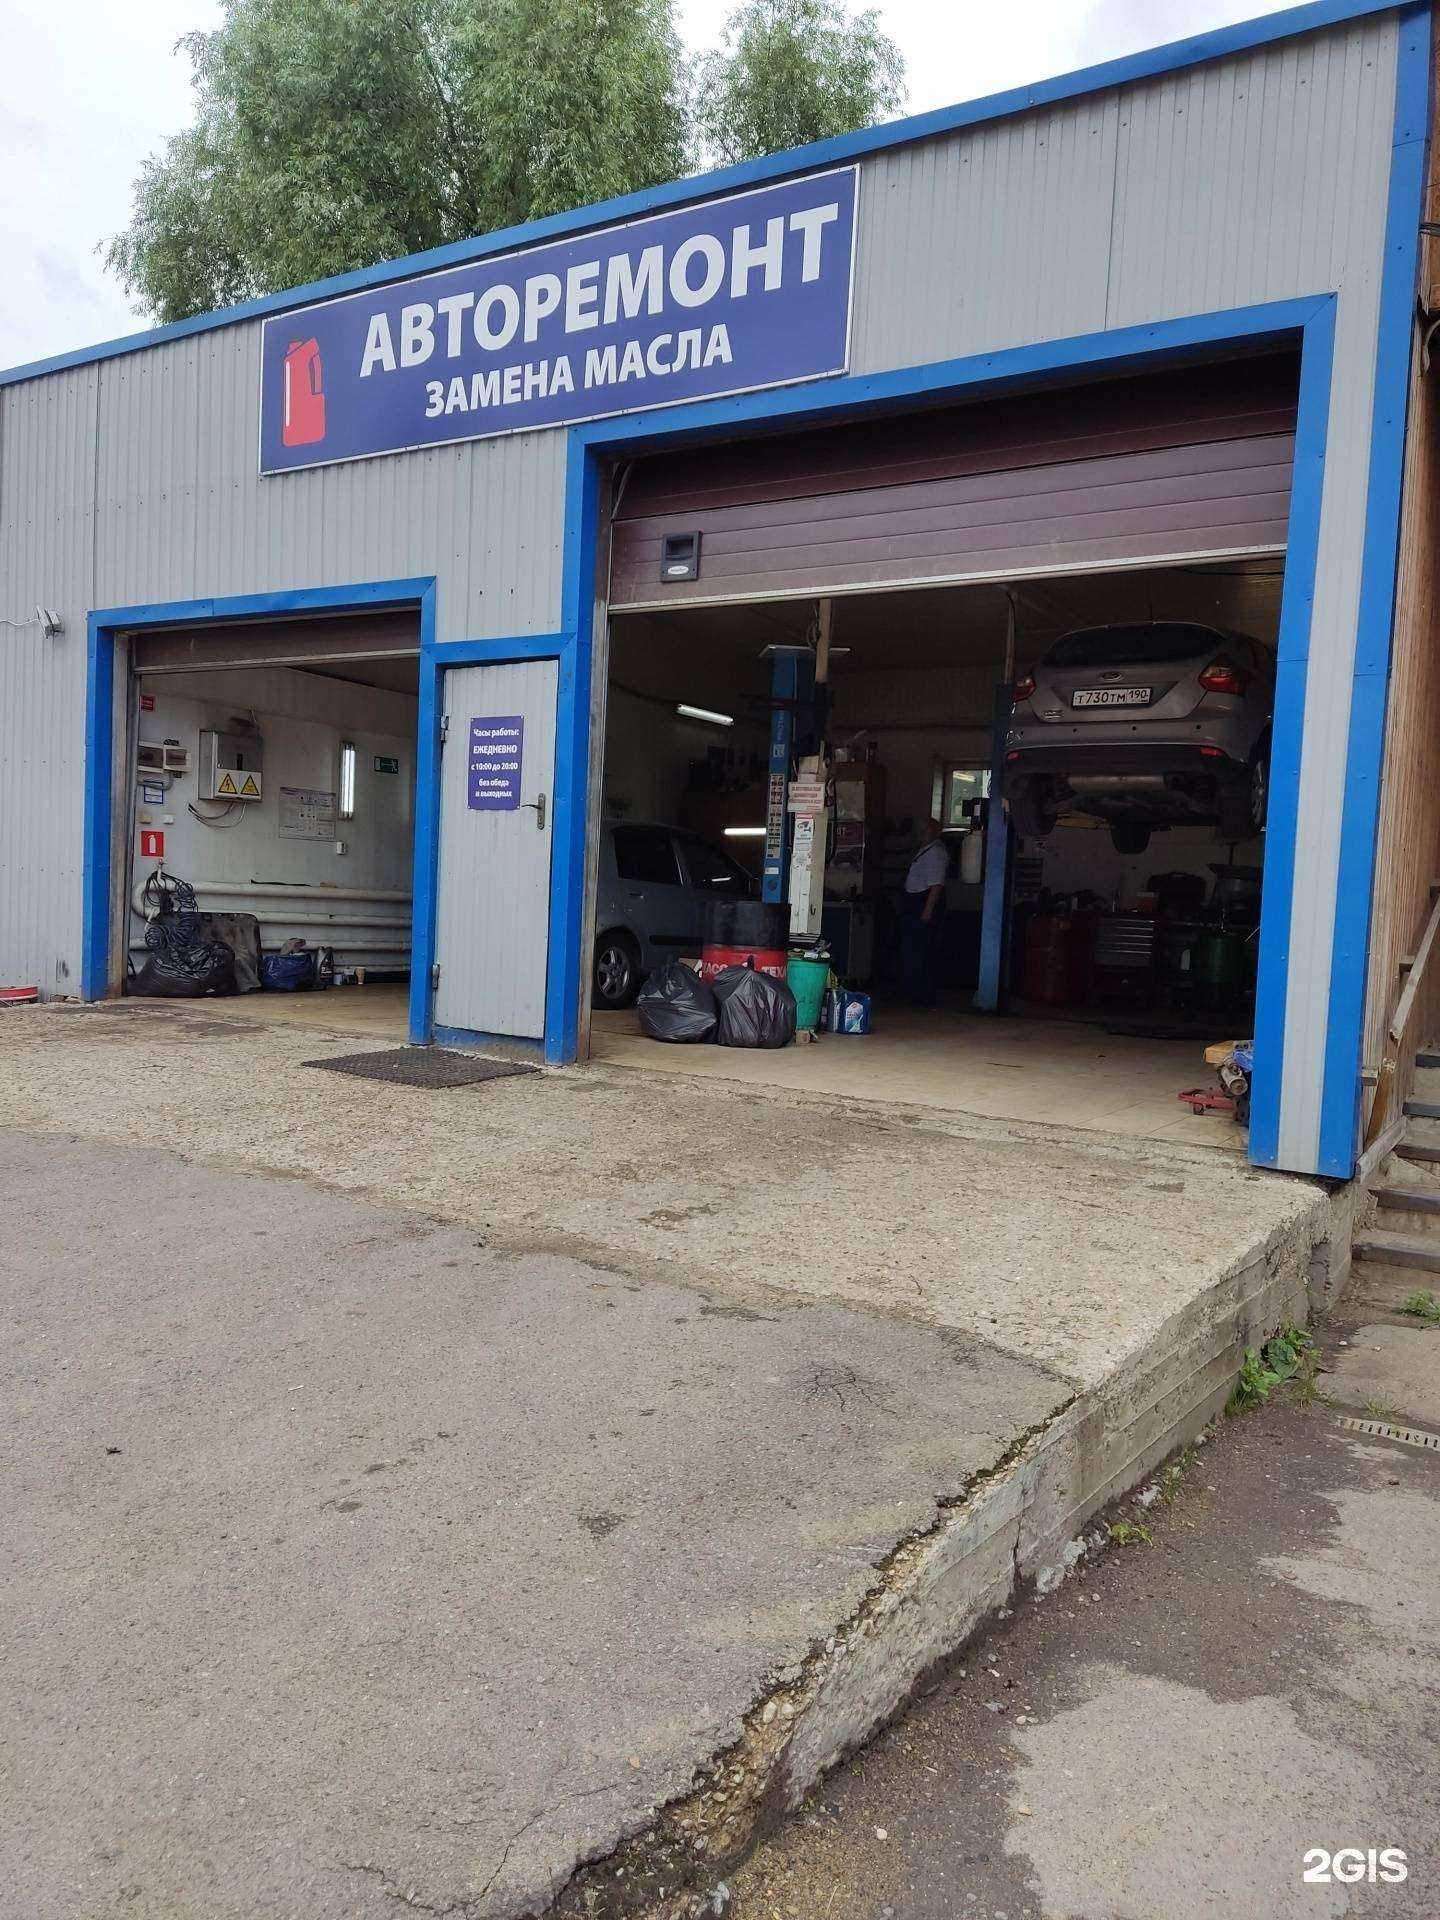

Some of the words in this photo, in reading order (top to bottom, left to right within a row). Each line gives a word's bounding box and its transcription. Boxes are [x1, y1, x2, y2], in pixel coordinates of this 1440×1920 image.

[360, 203, 839, 378] АВТОРЕМОНТ
[425, 355, 576, 418] ЗАМЕНА
[584, 324, 734, 388] МАСЛА
[1128, 689, 1148, 699] 190
[491, 728, 519, 738] работы:
[473, 745, 517, 755] ЕЖЕДНЕВНО
[475, 762, 492, 771] 10:00
[492, 764, 500, 772] до
[501, 762, 518, 770] 20:00
[490, 778, 509, 788] обеда
